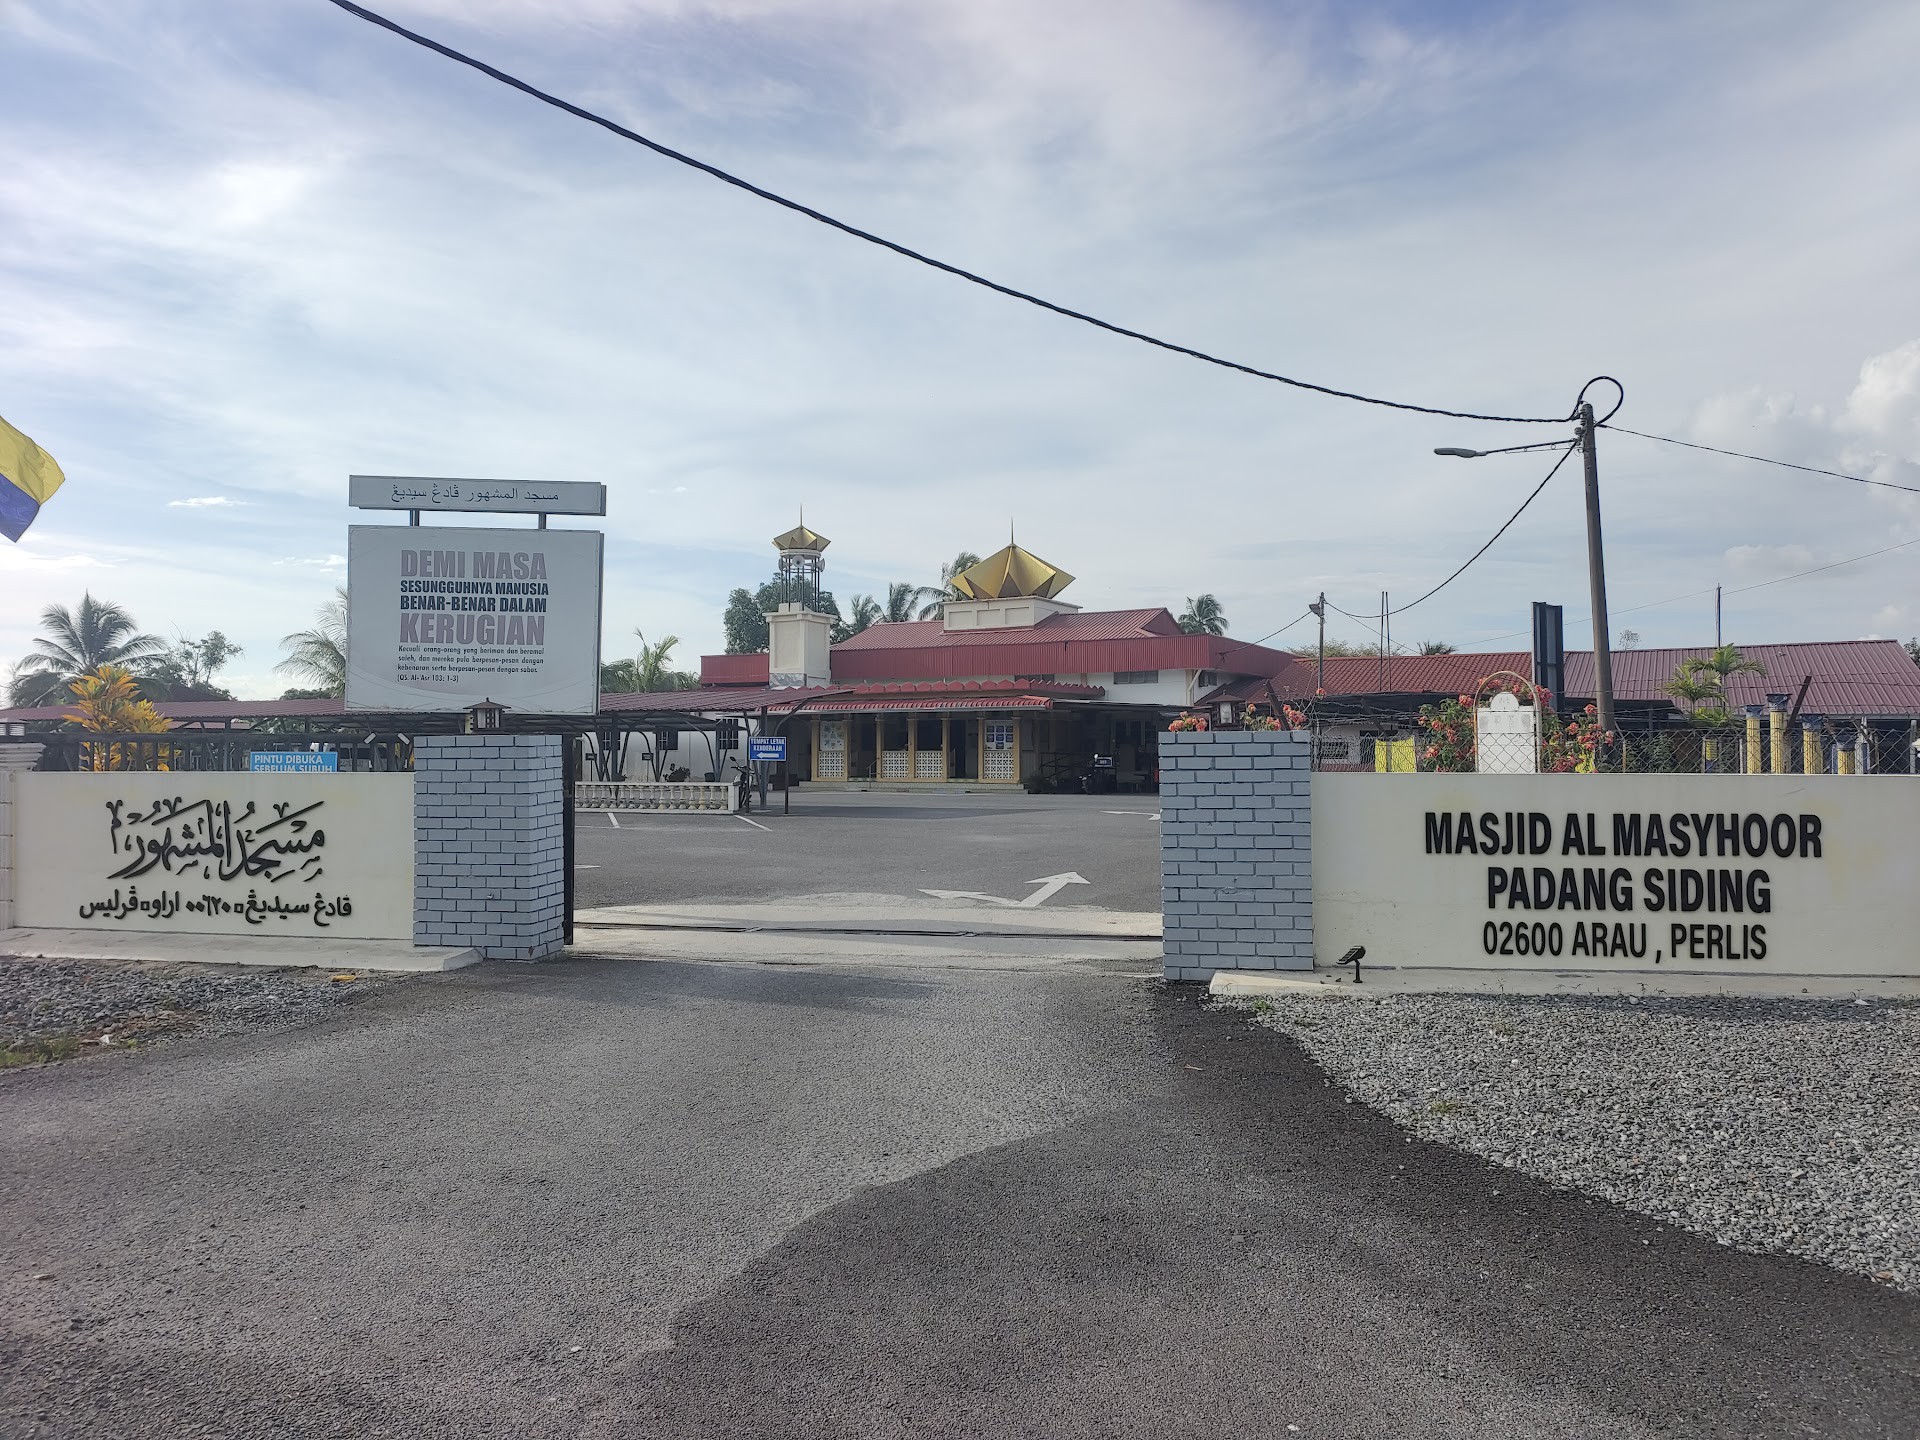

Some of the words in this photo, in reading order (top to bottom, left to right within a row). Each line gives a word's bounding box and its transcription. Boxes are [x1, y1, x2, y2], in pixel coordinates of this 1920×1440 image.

[465, 487, 518, 502] المشهور
[525, 490, 559, 503] مسجد
[400, 549, 465, 578] DEMI
[473, 551, 547, 580] MASA
[400, 580, 493, 594] SESUNGGUHNYA
[495, 582, 549, 595] MANUSIA
[400, 595, 496, 612] BENAR-BENAR
[499, 597, 547, 612] DALAM
[400, 613, 545, 646] KERUGIAN
[423, 646, 461, 654] orang-orang
[480, 646, 504, 654] beriman
[472, 656, 519, 664] berpesan-pesan
[521, 657, 543, 665] dengan
[397, 663, 429, 671] kebenaran
[449, 664, 495, 673] berpesan-pesan
[496, 666, 519, 674] dengan
[254, 754, 282, 764] PINTU
[285, 754, 323, 764] DIBUKA
[1424, 812, 1552, 855] MASJID
[1561, 813, 1606, 855] AL
[1612, 813, 1823, 858] MASYHOOR
[1488, 867, 1634, 911] PADANG
[1643, 868, 1771, 914] SIDING
[1483, 921, 1563, 956] 02600
[1571, 922, 1647, 958] ARAU
[1670, 924, 1768, 960] PERLIS
